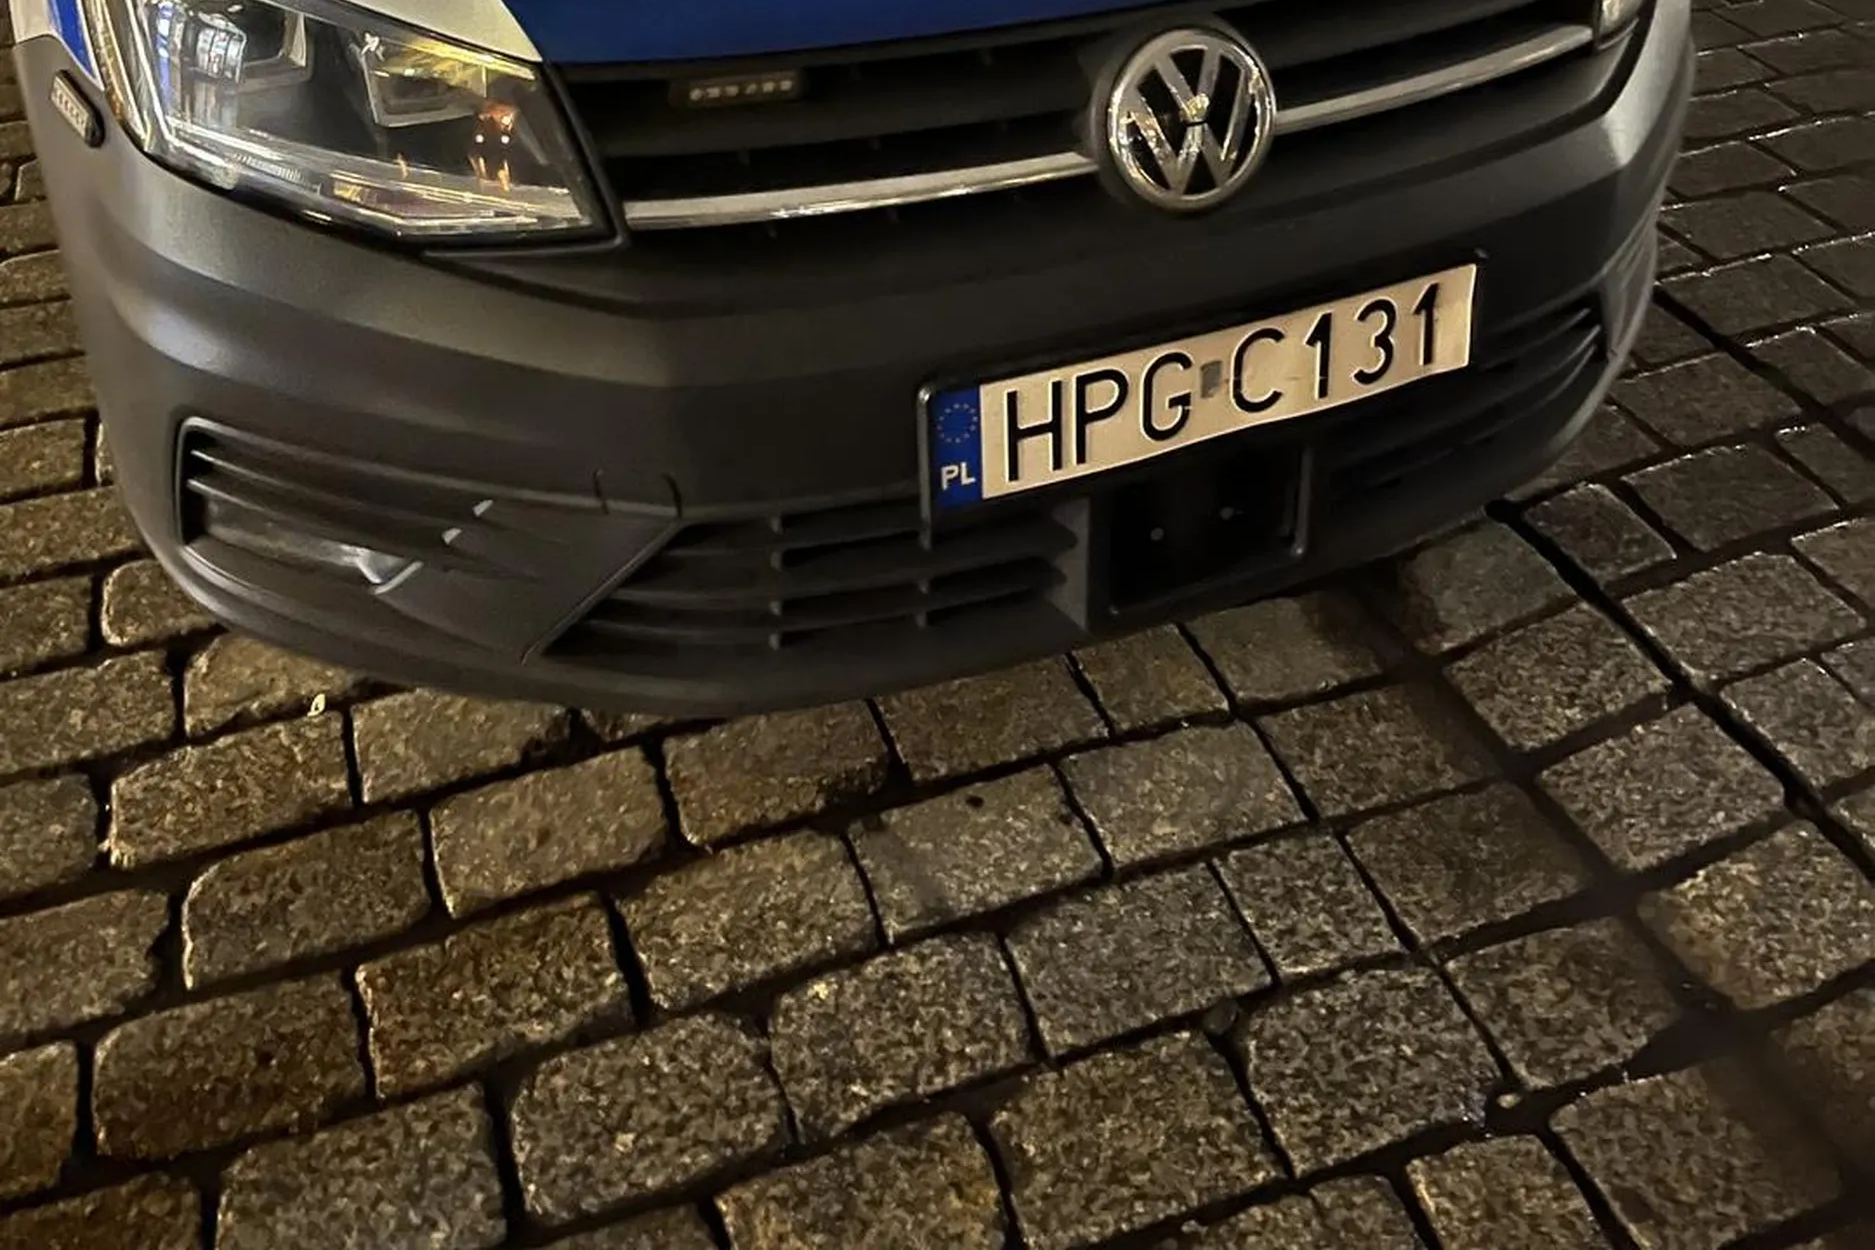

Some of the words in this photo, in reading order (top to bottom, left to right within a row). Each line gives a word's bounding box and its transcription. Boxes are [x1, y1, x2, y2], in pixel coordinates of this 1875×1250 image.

[1107, 28, 1277, 210] VW
[1005, 351, 1194, 482] HPG
[1231, 282, 1442, 413] C131
[940, 461, 976, 490] PL
